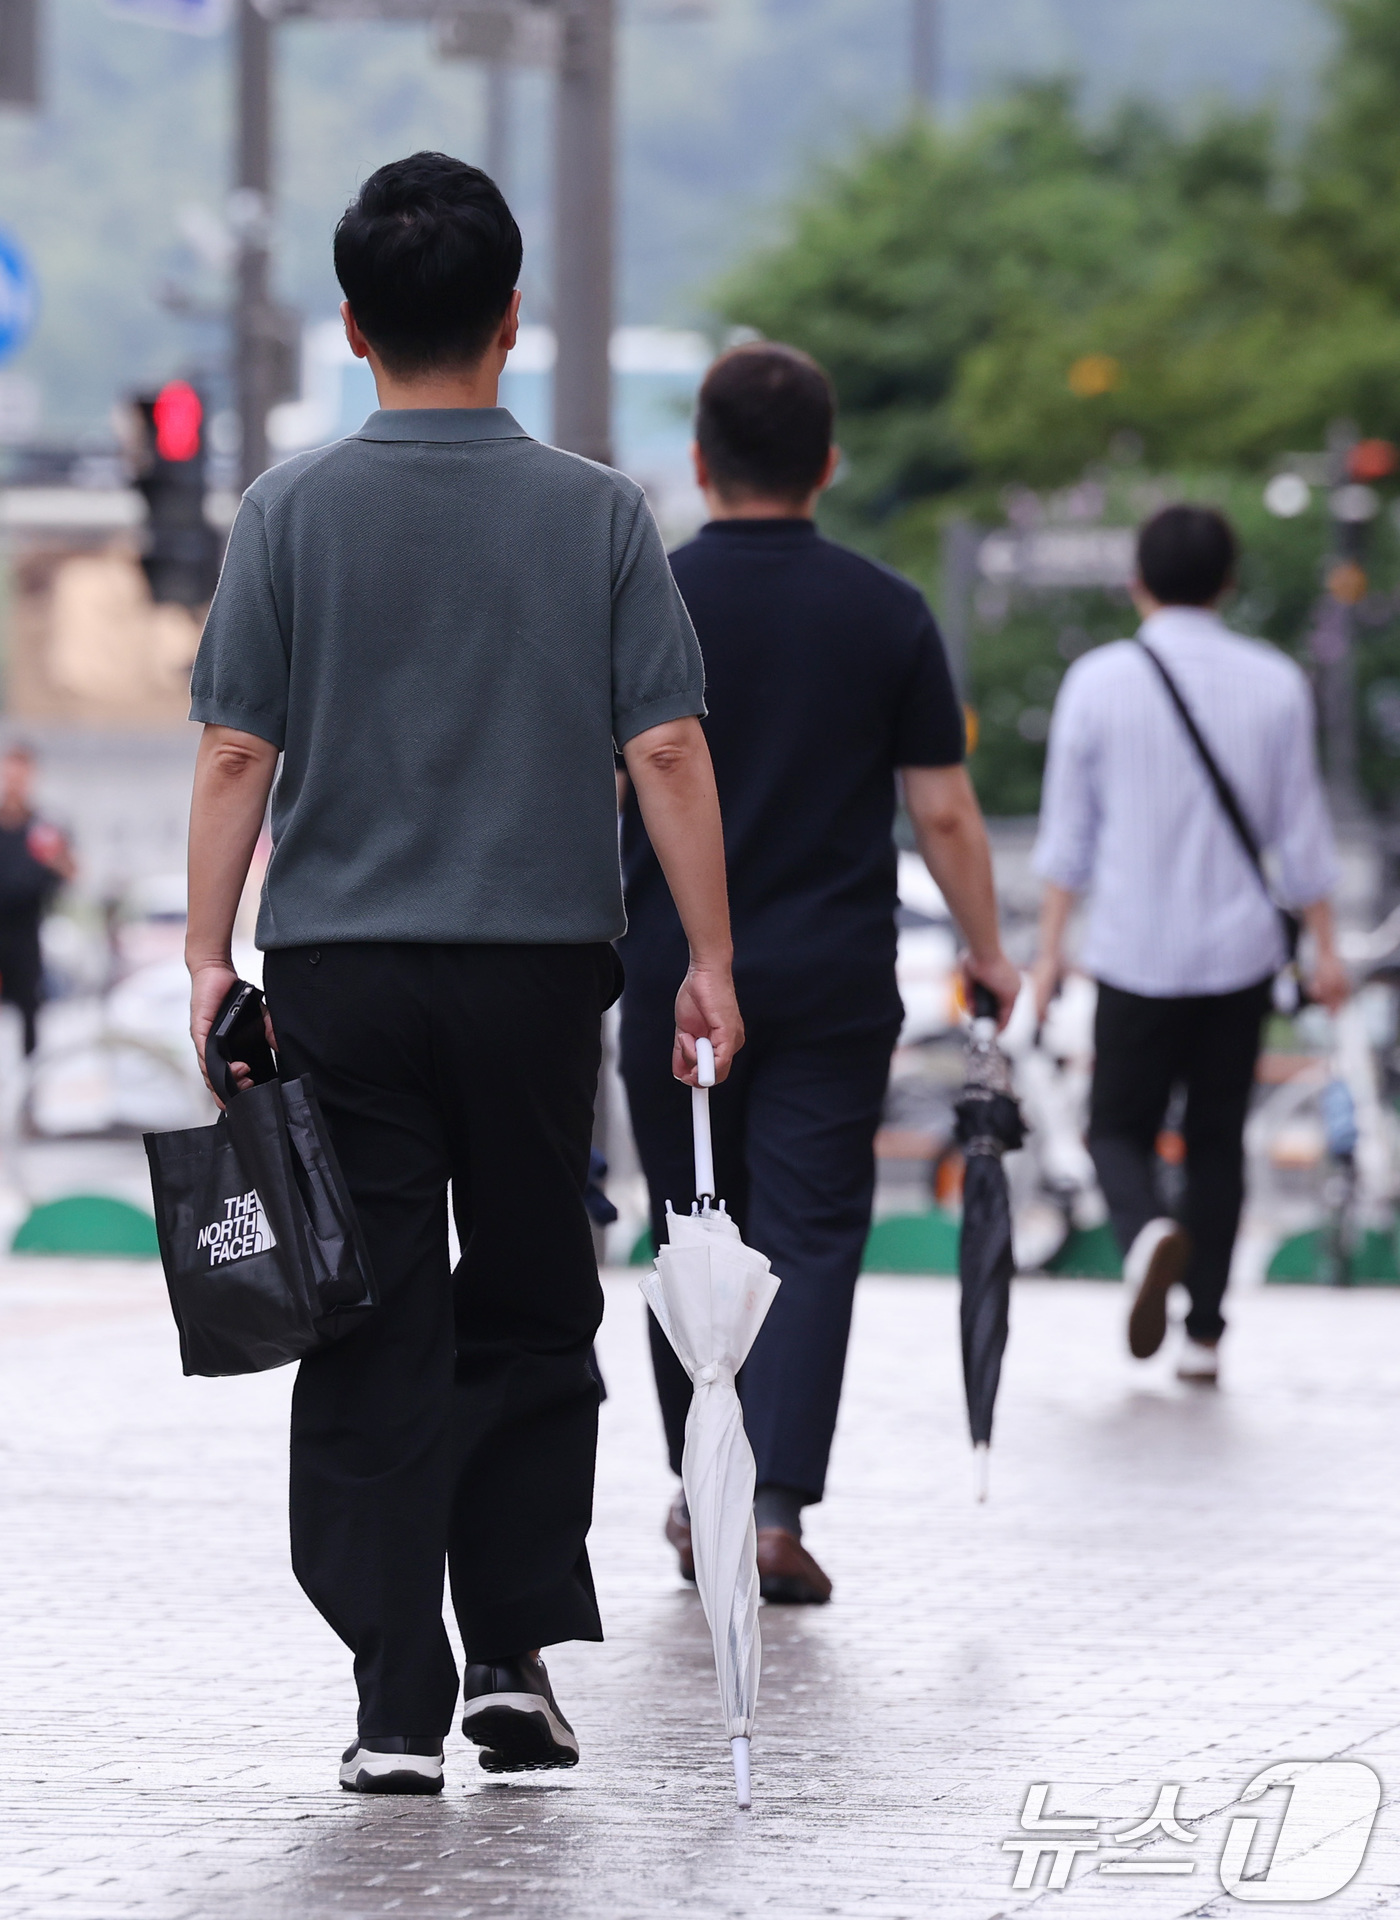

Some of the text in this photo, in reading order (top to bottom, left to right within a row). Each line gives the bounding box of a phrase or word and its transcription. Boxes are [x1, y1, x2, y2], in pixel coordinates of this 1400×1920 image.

[224, 1190, 257, 1219] THE
[197, 1212, 257, 1250] NORTH
[210, 1233, 255, 1266] FACE
